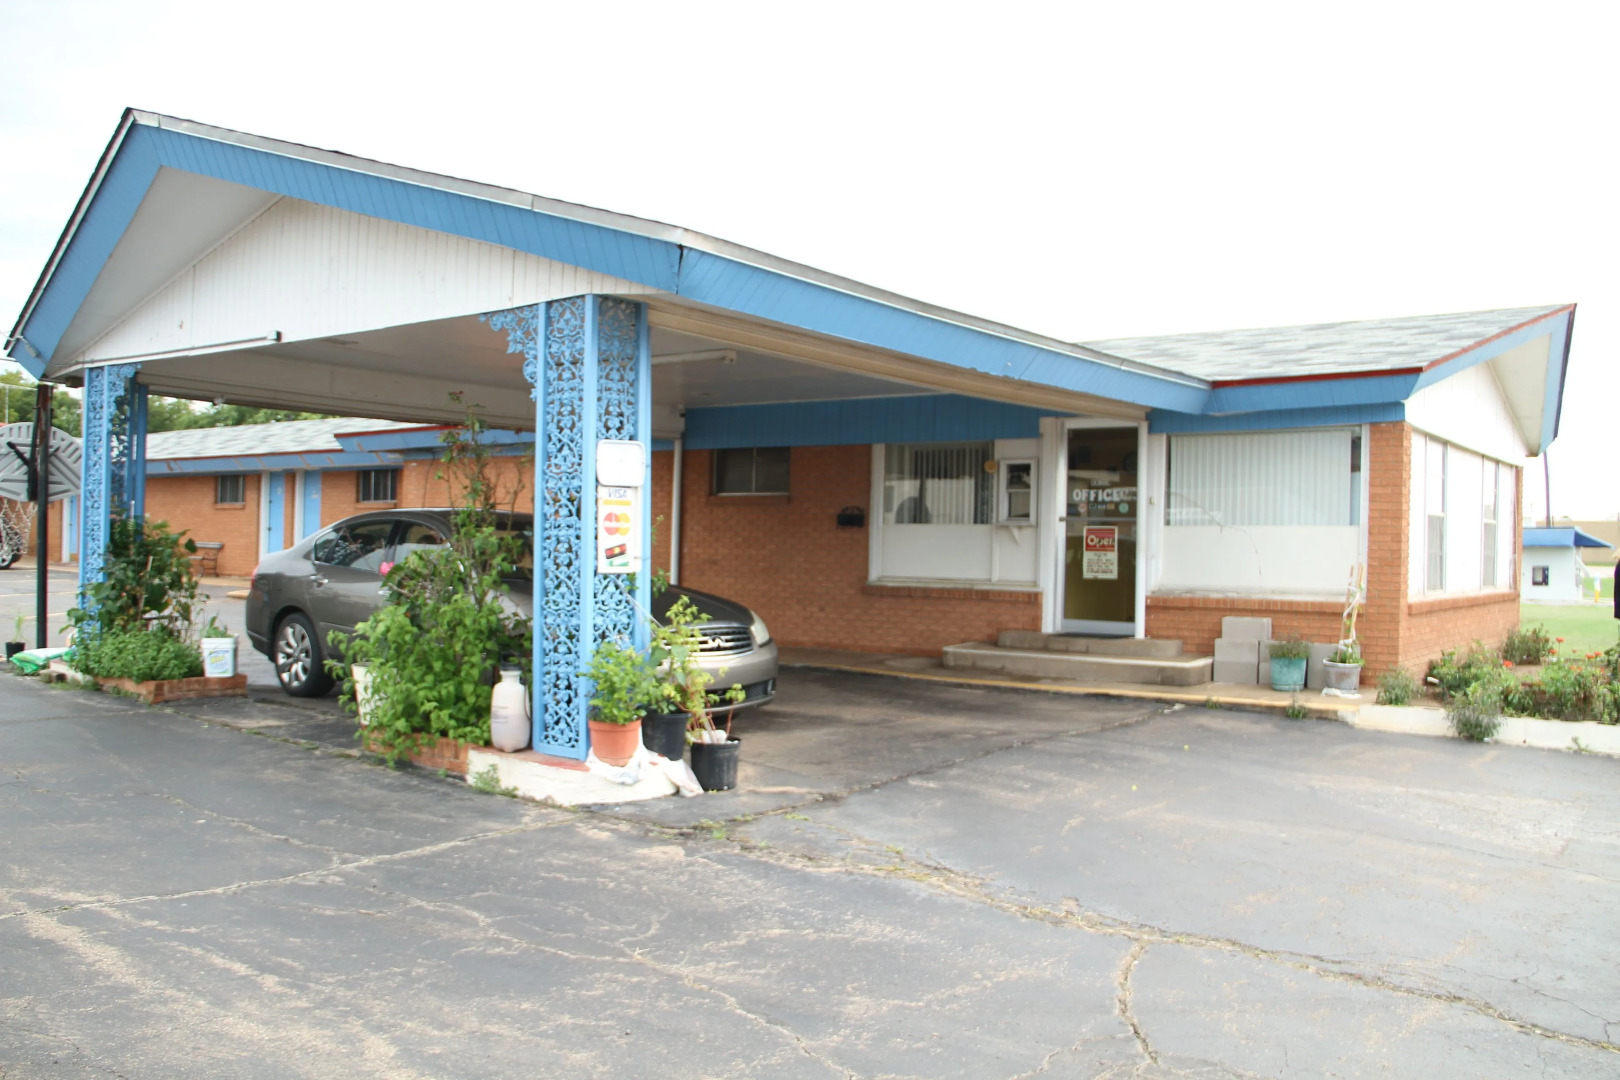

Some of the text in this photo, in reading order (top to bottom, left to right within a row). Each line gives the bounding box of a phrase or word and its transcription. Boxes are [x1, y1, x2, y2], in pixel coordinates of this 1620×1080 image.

[608, 488, 627, 499] VISA
[1073, 489, 1121, 503] OFFICE
[1087, 534, 1115, 548] Open
